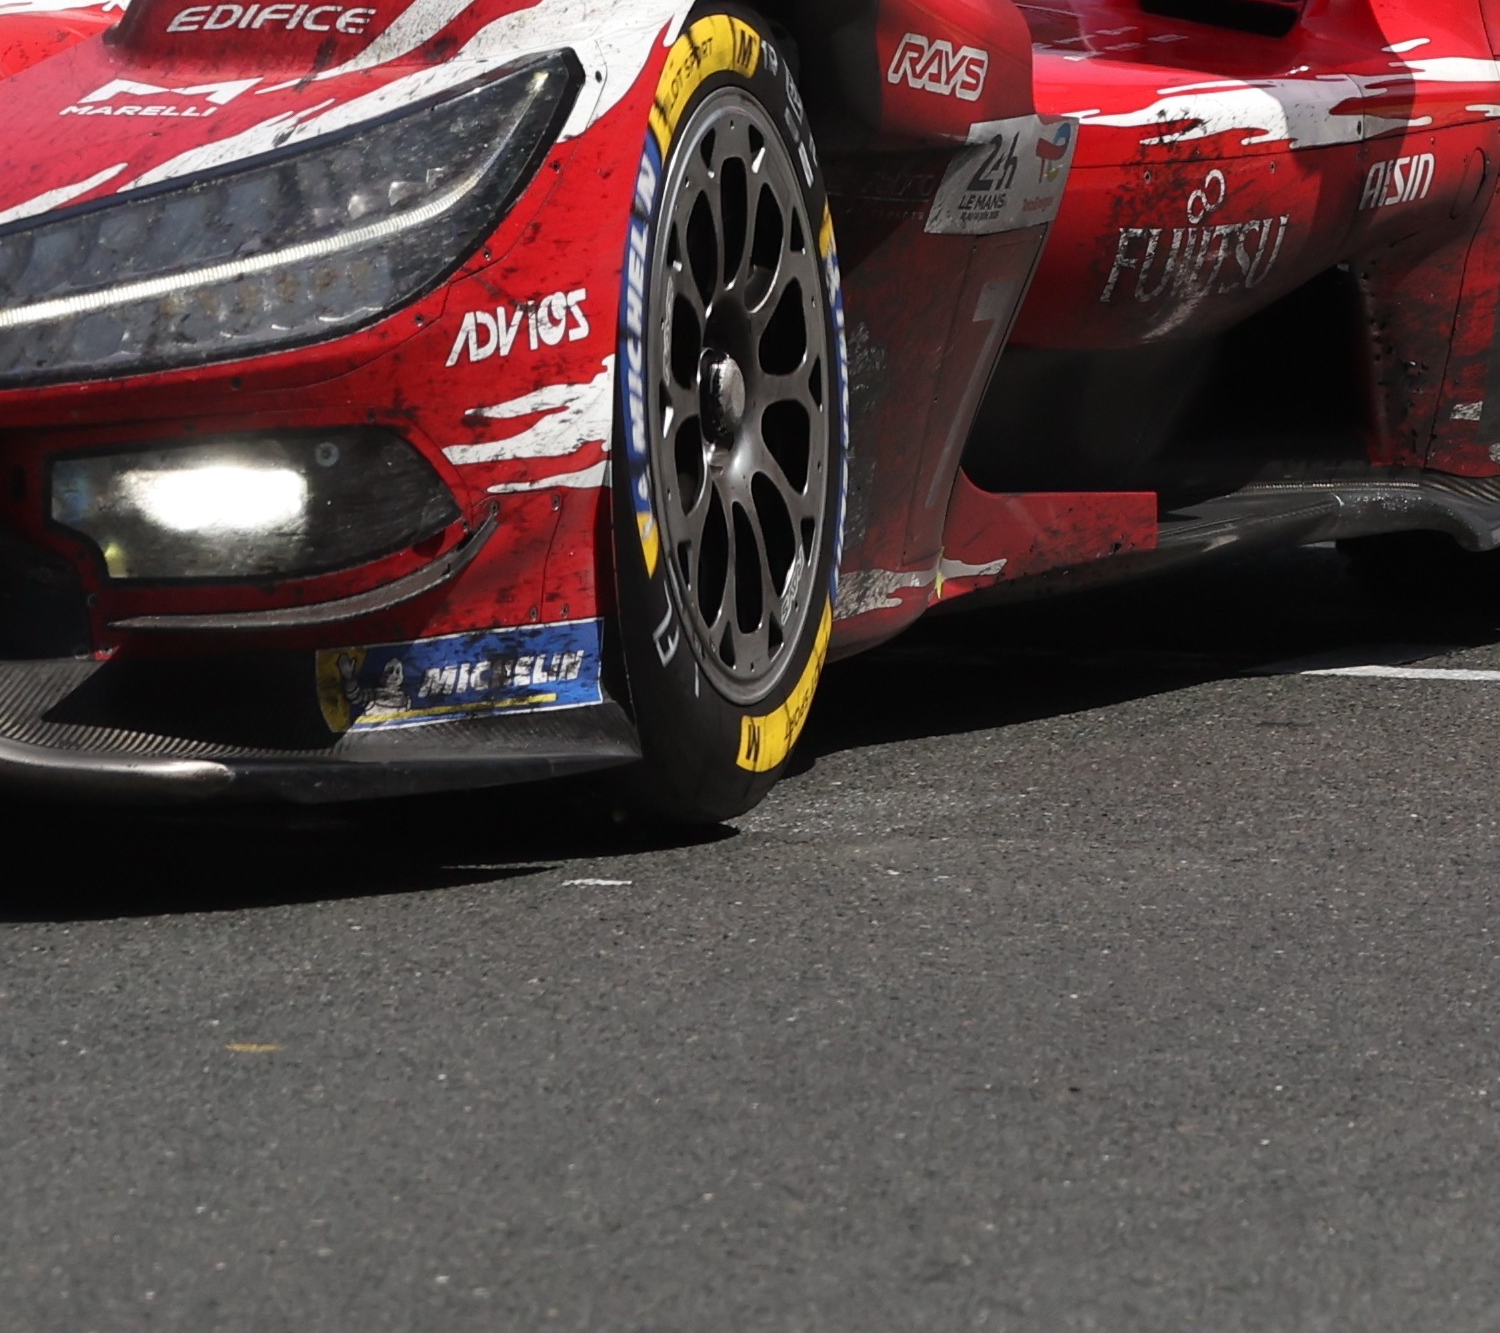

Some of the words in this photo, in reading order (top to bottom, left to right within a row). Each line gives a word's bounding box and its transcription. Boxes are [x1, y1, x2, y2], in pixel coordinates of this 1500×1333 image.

[166, 3, 378, 34] EDIFICE
[887, 33, 990, 102] RAYS
[58, 104, 220, 118] MARELLI
[1358, 152, 1435, 211] AISIN
[958, 194, 975, 211] LE
[976, 193, 1008, 210] MANS
